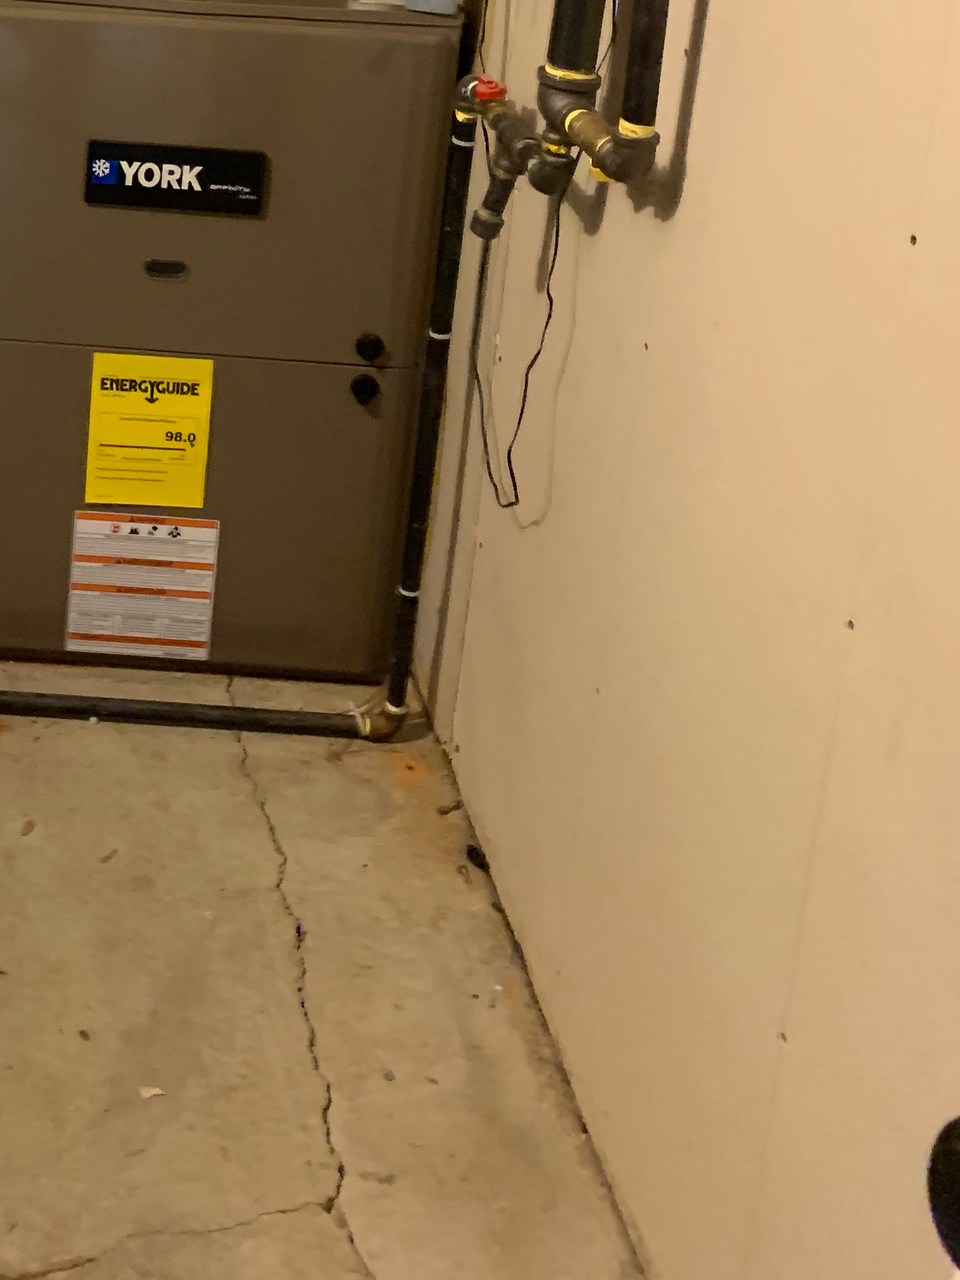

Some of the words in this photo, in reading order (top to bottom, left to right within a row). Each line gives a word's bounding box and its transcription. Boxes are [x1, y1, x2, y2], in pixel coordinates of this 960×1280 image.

[119, 159, 205, 192] YORK
[99, 376, 201, 398] ENERGYGUIDE
[165, 430, 197, 443] 98.0
